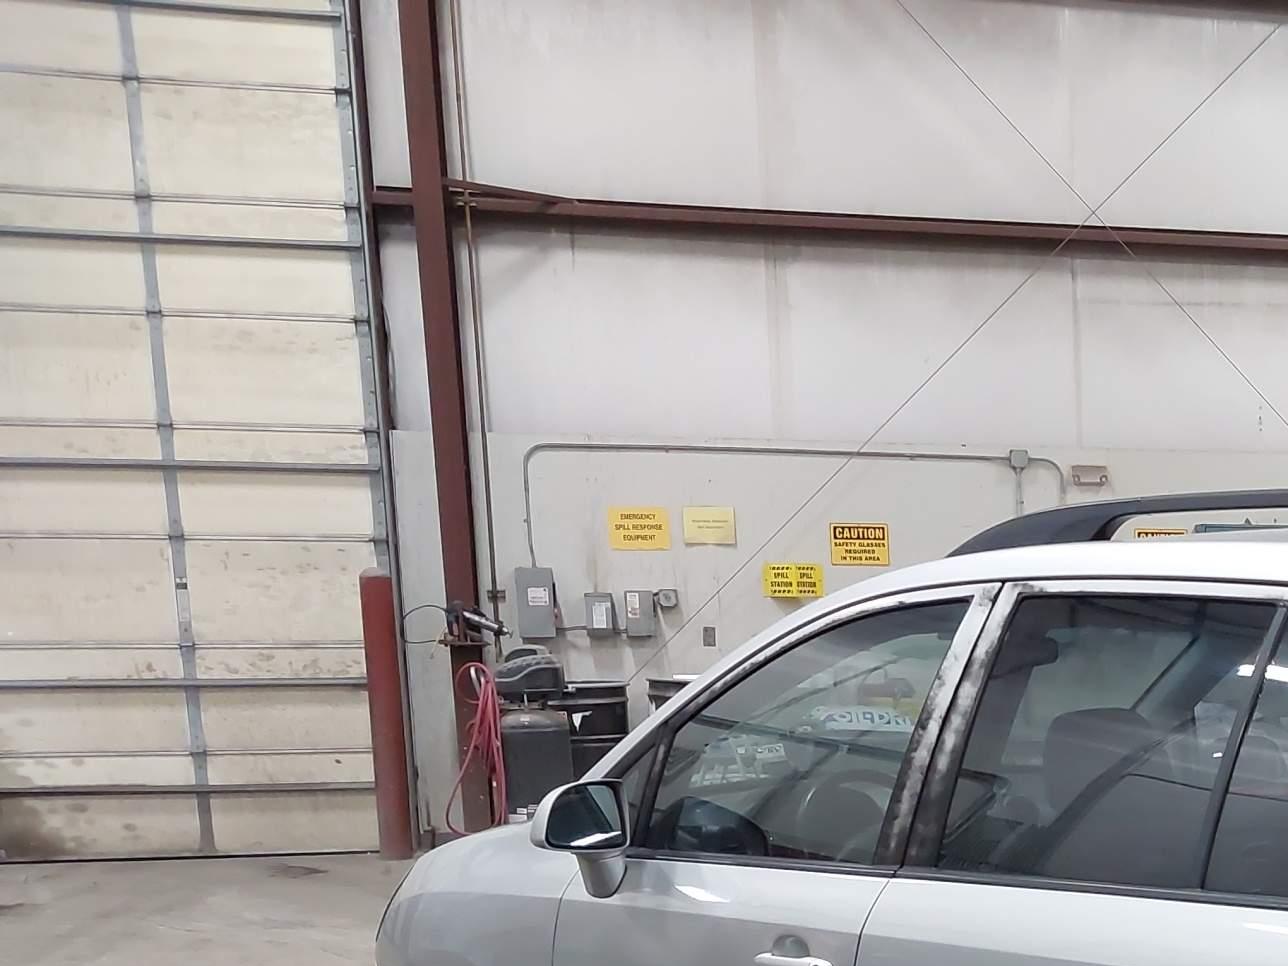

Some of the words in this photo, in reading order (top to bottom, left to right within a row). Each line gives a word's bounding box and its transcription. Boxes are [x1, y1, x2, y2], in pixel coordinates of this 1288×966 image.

[835, 527, 883, 539] CAUTION
[770, 580, 792, 588] STATION
[796, 580, 816, 588] STATION
